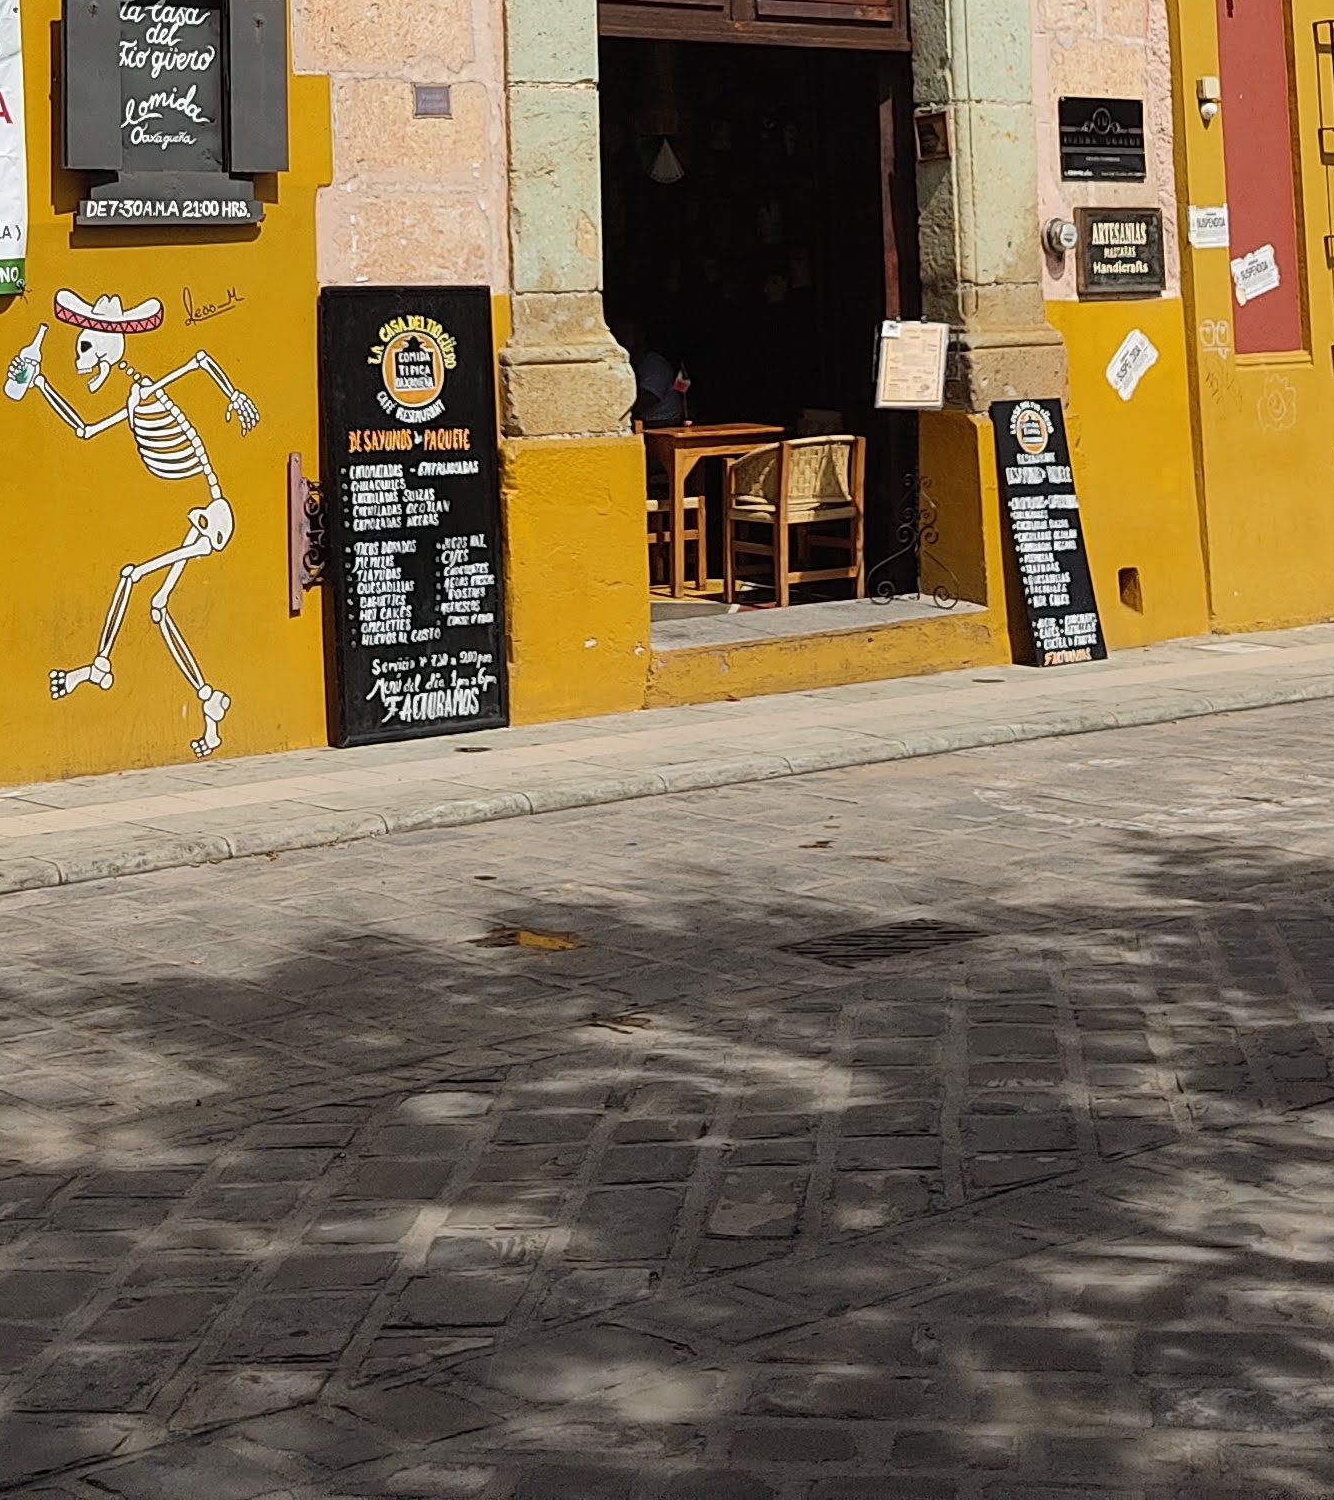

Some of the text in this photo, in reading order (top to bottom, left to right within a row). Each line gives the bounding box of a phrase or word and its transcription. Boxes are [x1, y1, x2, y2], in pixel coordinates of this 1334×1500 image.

[182, 200, 220, 218] 21:00
[221, 200, 251, 218] HRS.
[1092, 222, 1147, 245] ARTESANIAS
[1093, 259, 1149, 275] Handicrafts
[367, 345, 385, 365] LA
[378, 316, 407, 343] CASA
[406, 315, 425, 331] DEL
[398, 351, 431, 363] COMIDA
[348, 428, 413, 453] DESAYUNOS
[424, 428, 471, 451] PAQUETE
[356, 580, 415, 595] QUESADILLAS
[359, 605, 413, 622] HOT CAKES
[403, 673, 422, 693] del
